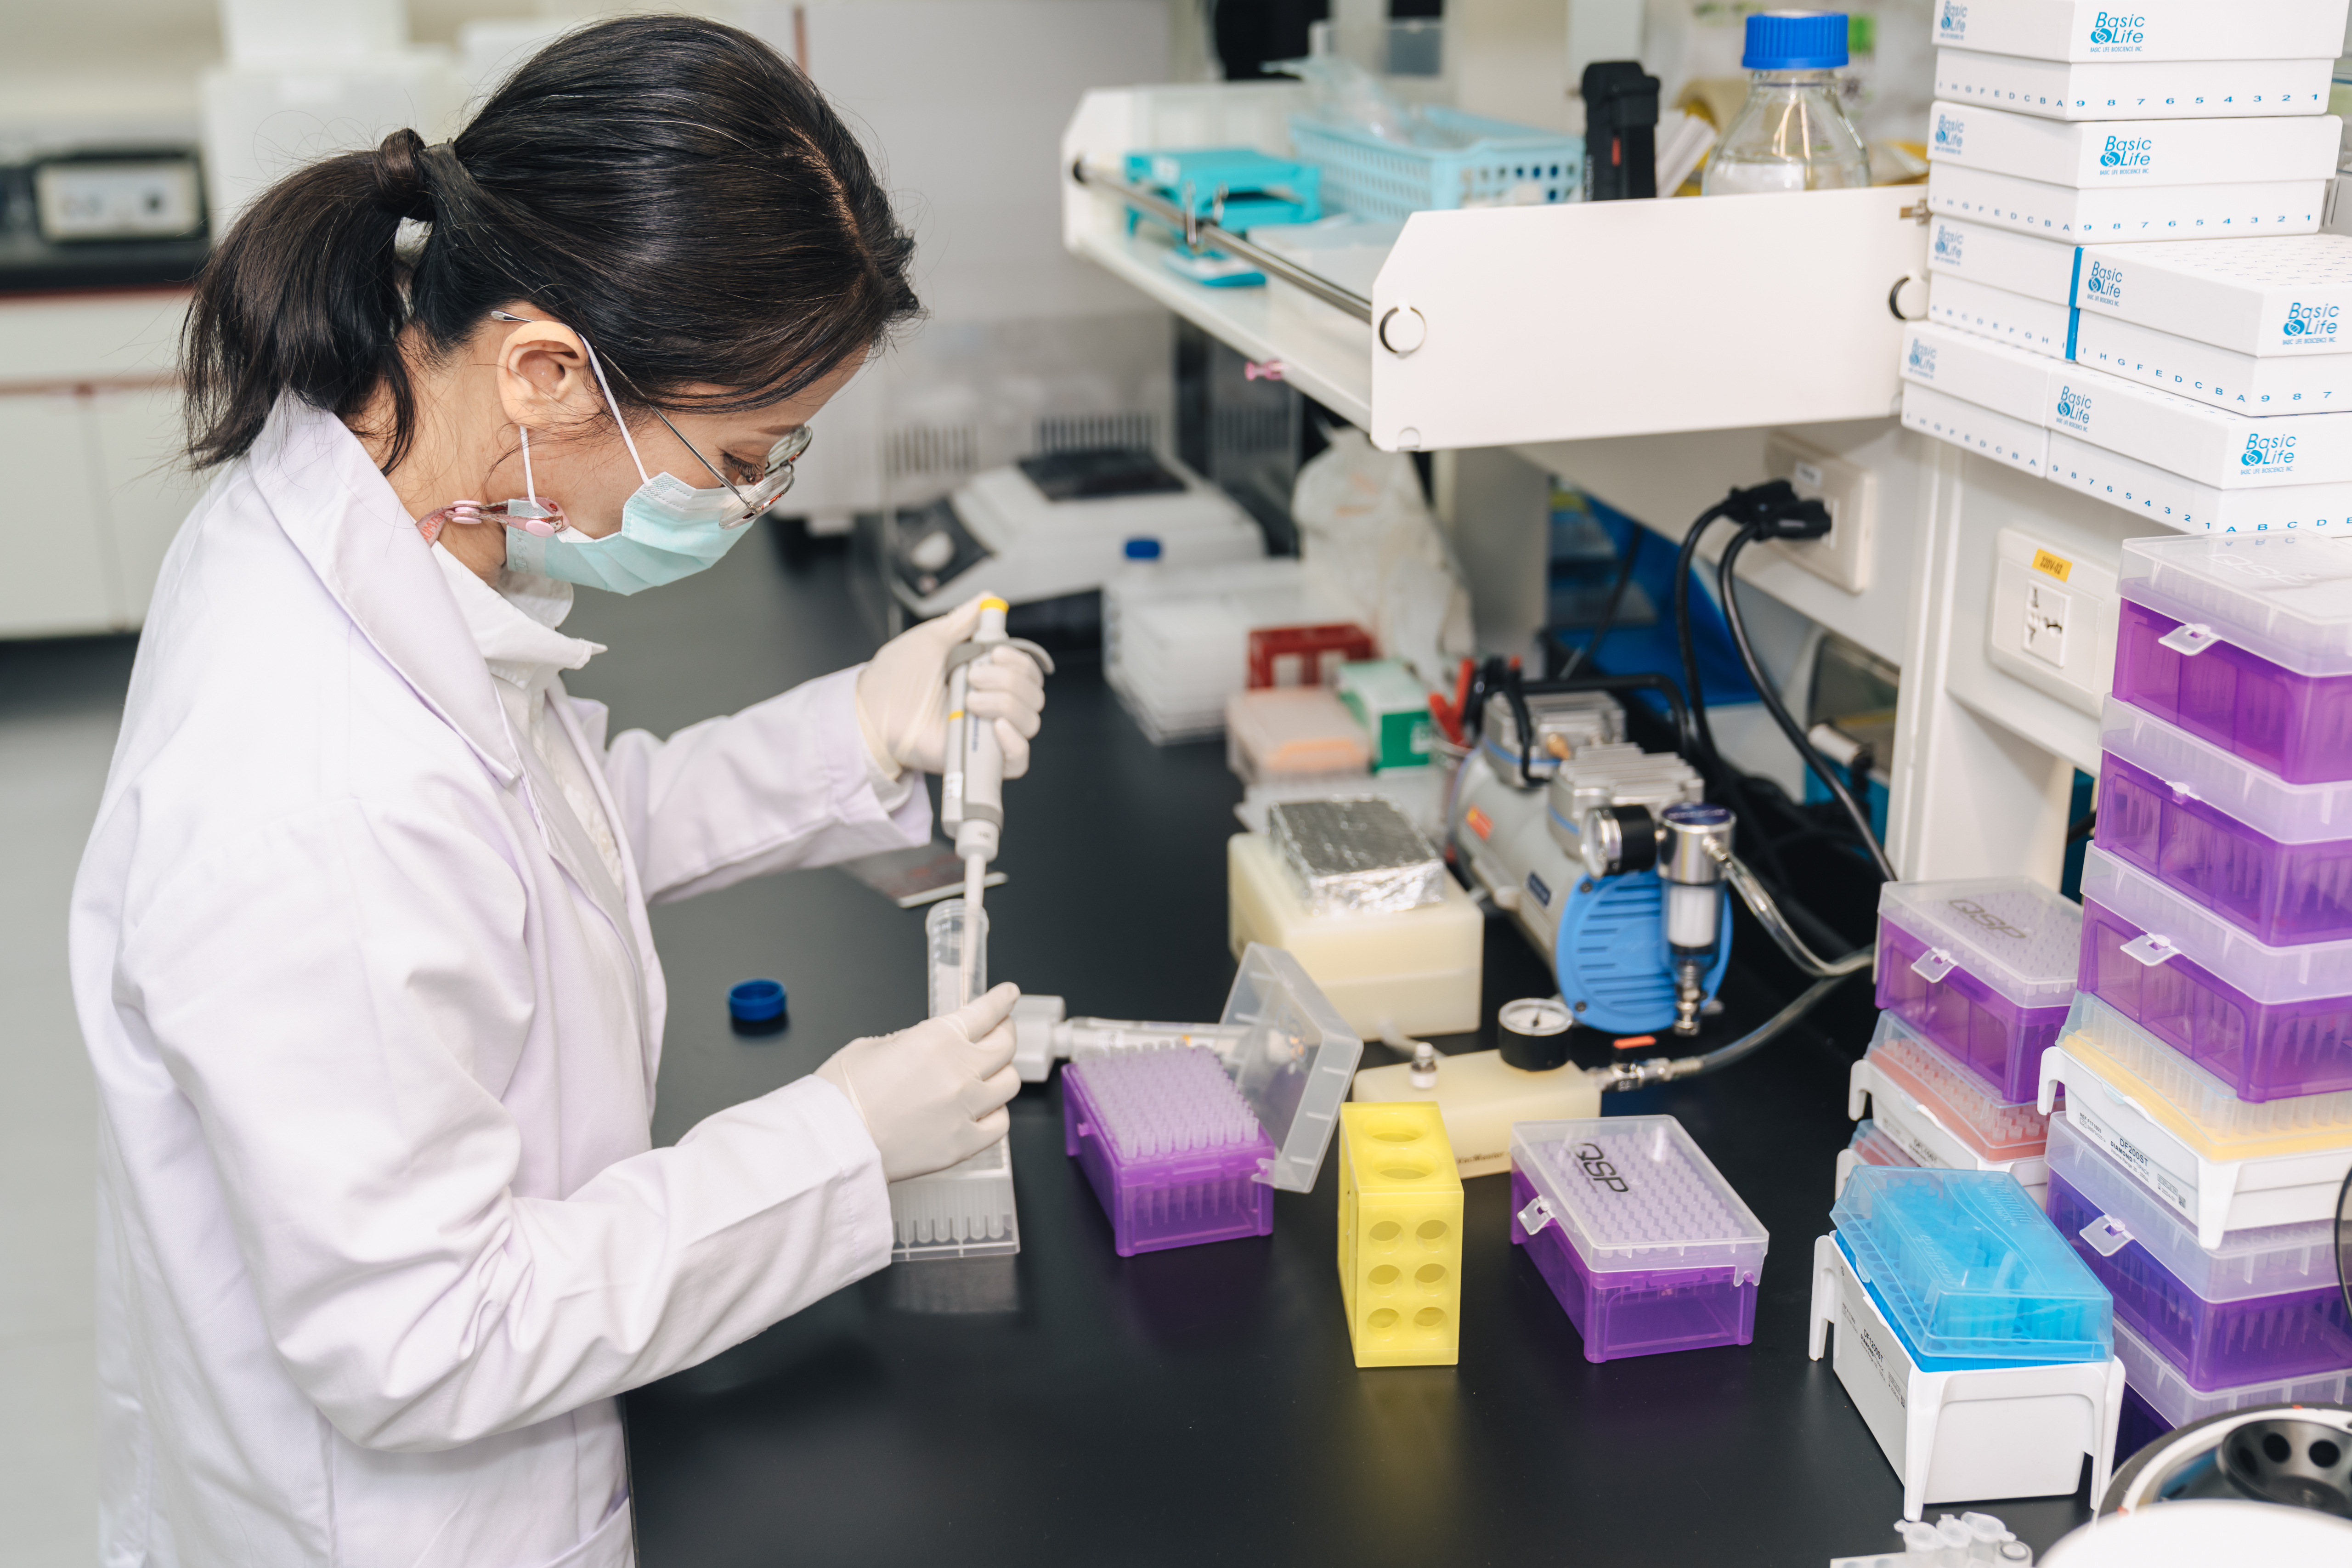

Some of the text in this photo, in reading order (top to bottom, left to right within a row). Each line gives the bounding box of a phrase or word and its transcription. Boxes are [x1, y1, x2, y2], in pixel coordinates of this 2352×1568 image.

[1943, 0, 1968, 17] Basic
[2095, 12, 2145, 28] Basic
[2112, 27, 2143, 44] Life
[1938, 114, 1964, 132] Basic
[2105, 136, 2152, 151] Basic
[2120, 151, 2150, 166] Life
[2010, 212, 2018, 220] D
[1938, 225, 1964, 245] Basic
[2092, 261, 2122, 283] Basic
[2101, 277, 2120, 298] Life
[2289, 302, 2340, 319] Basic
[2305, 318, 2337, 334] Life
[2060, 386, 2092, 409] Basic
[2070, 403, 2089, 424] Life
[2246, 434, 2297, 450] Basic
[2262, 448, 2295, 464] Life
[1948, 900, 2027, 938] QSP
[2110, 1141, 2132, 1162] DIAMOND
[2120, 1138, 2148, 1166] DF200ST
[1571, 1143, 1629, 1192] QSP
[1860, 1334, 1874, 1357] DIAMOND
[1864, 1329, 1883, 1363] DF1200ST
